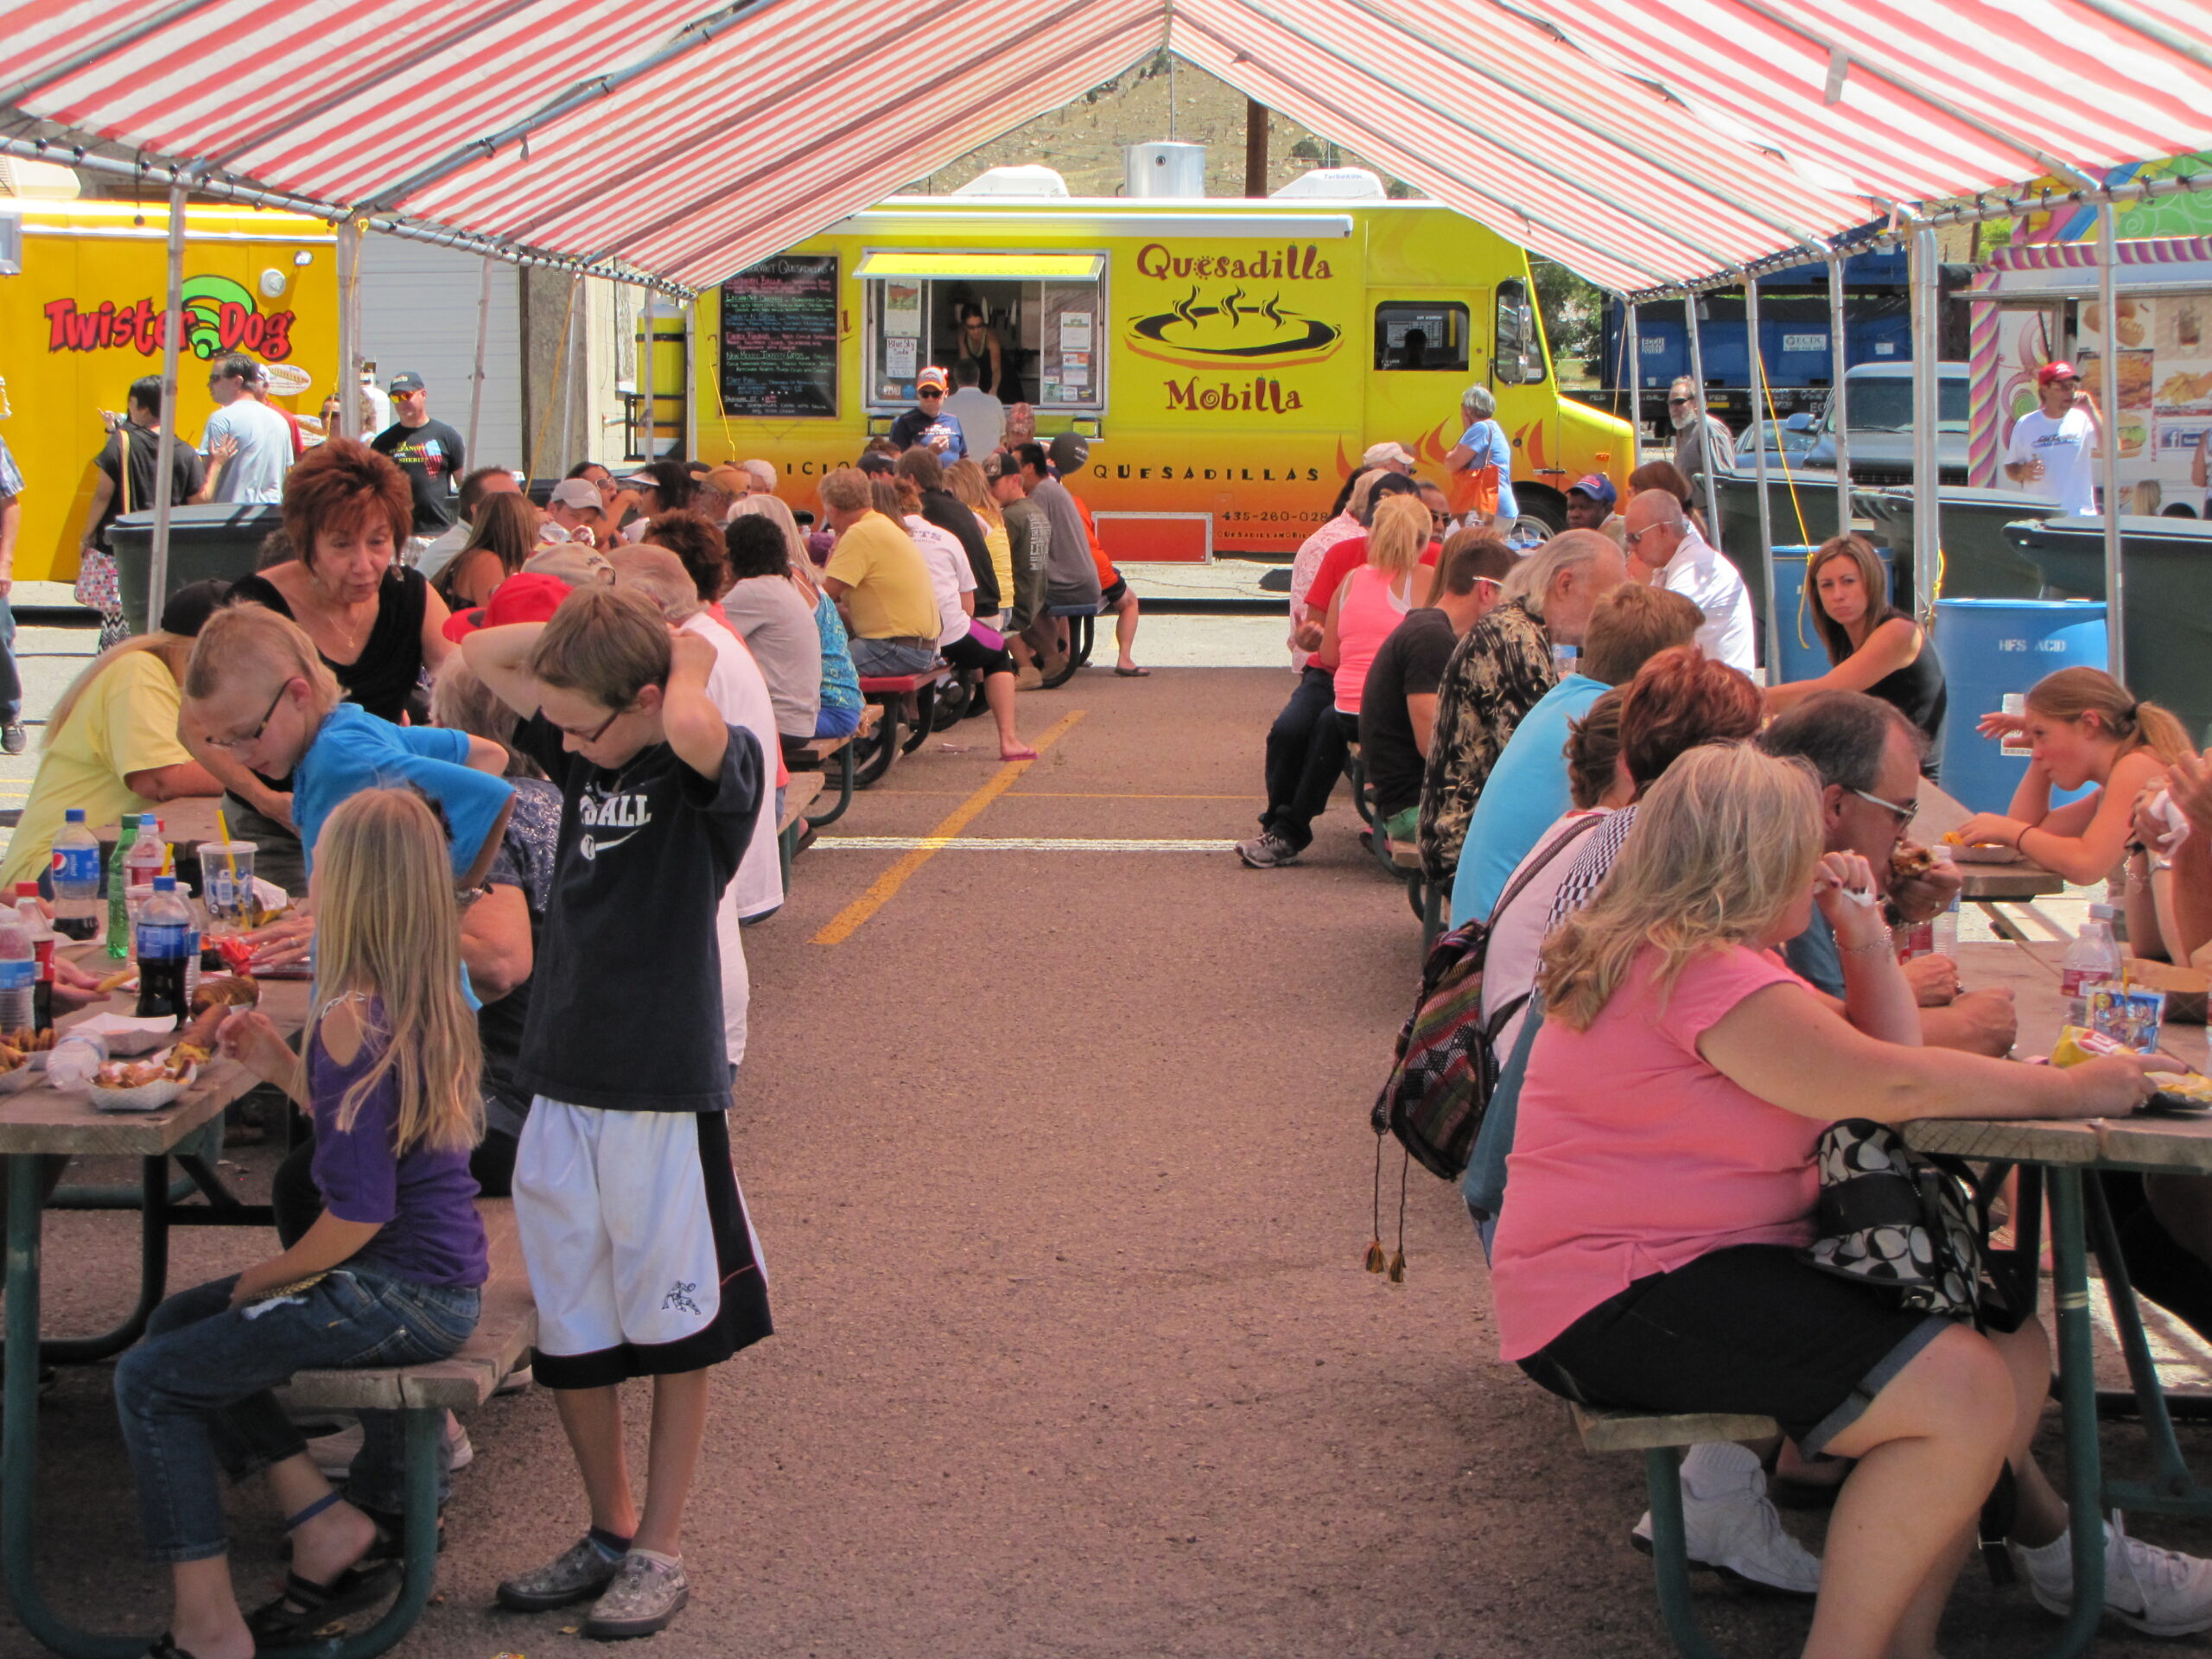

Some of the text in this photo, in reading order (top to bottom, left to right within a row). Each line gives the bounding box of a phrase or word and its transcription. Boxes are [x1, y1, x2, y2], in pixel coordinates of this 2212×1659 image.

[1136, 241, 1334, 282] Quesadilla
[44, 296, 296, 361] Twister Dog
[1163, 373, 1303, 414] Mobilla
[1093, 464, 1319, 481] QUESADILLAS
[1222, 511, 1329, 522] 435-260-028
[1999, 639, 2067, 652] HFS ACID
